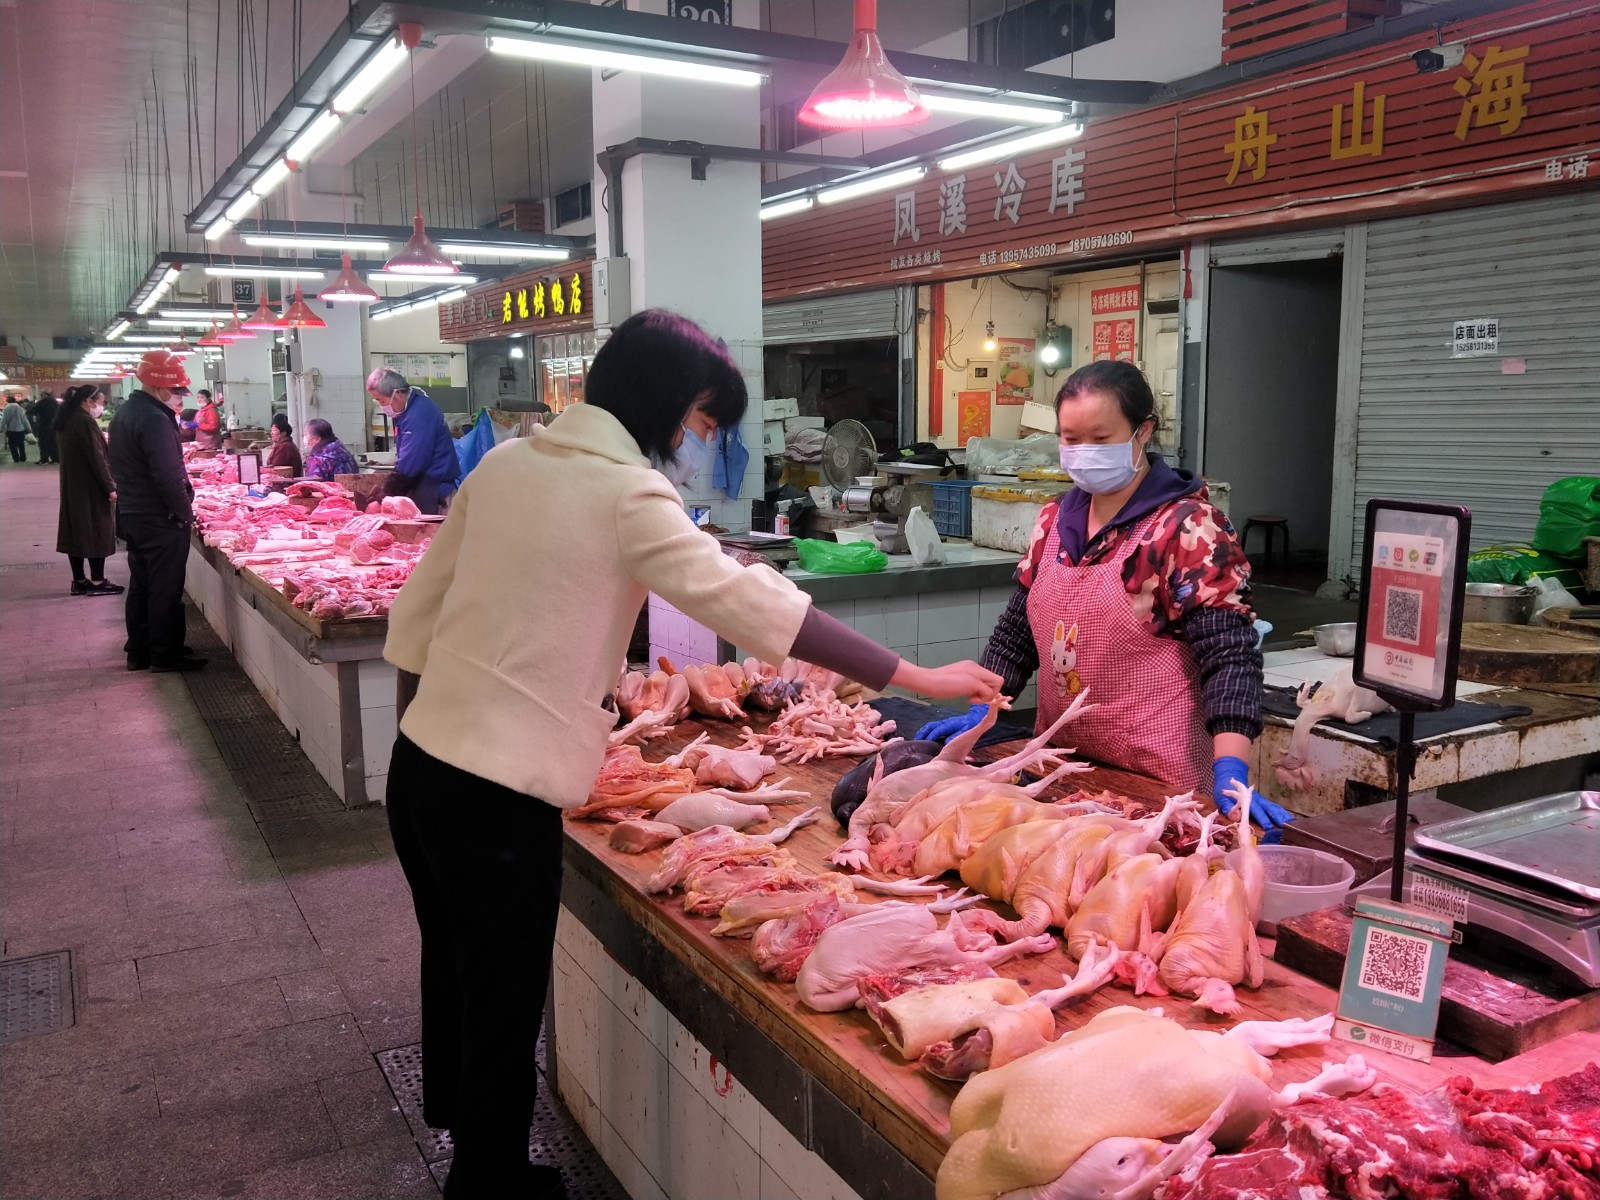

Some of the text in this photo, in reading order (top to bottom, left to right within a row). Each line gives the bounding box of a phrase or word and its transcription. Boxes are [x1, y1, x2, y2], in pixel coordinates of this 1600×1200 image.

[1224, 45, 1531, 185] 舟山海
[1545, 155, 1589, 183] 电话
[893, 147, 1087, 247] 凤溪冷库
[979, 250, 997, 266] 电话
[1000, 243, 1057, 263] 13957435099
[235, 284, 250, 295] 37
[1455, 323, 1497, 340] 店面出租
[1369, 1031, 1415, 1055] 微信支付
